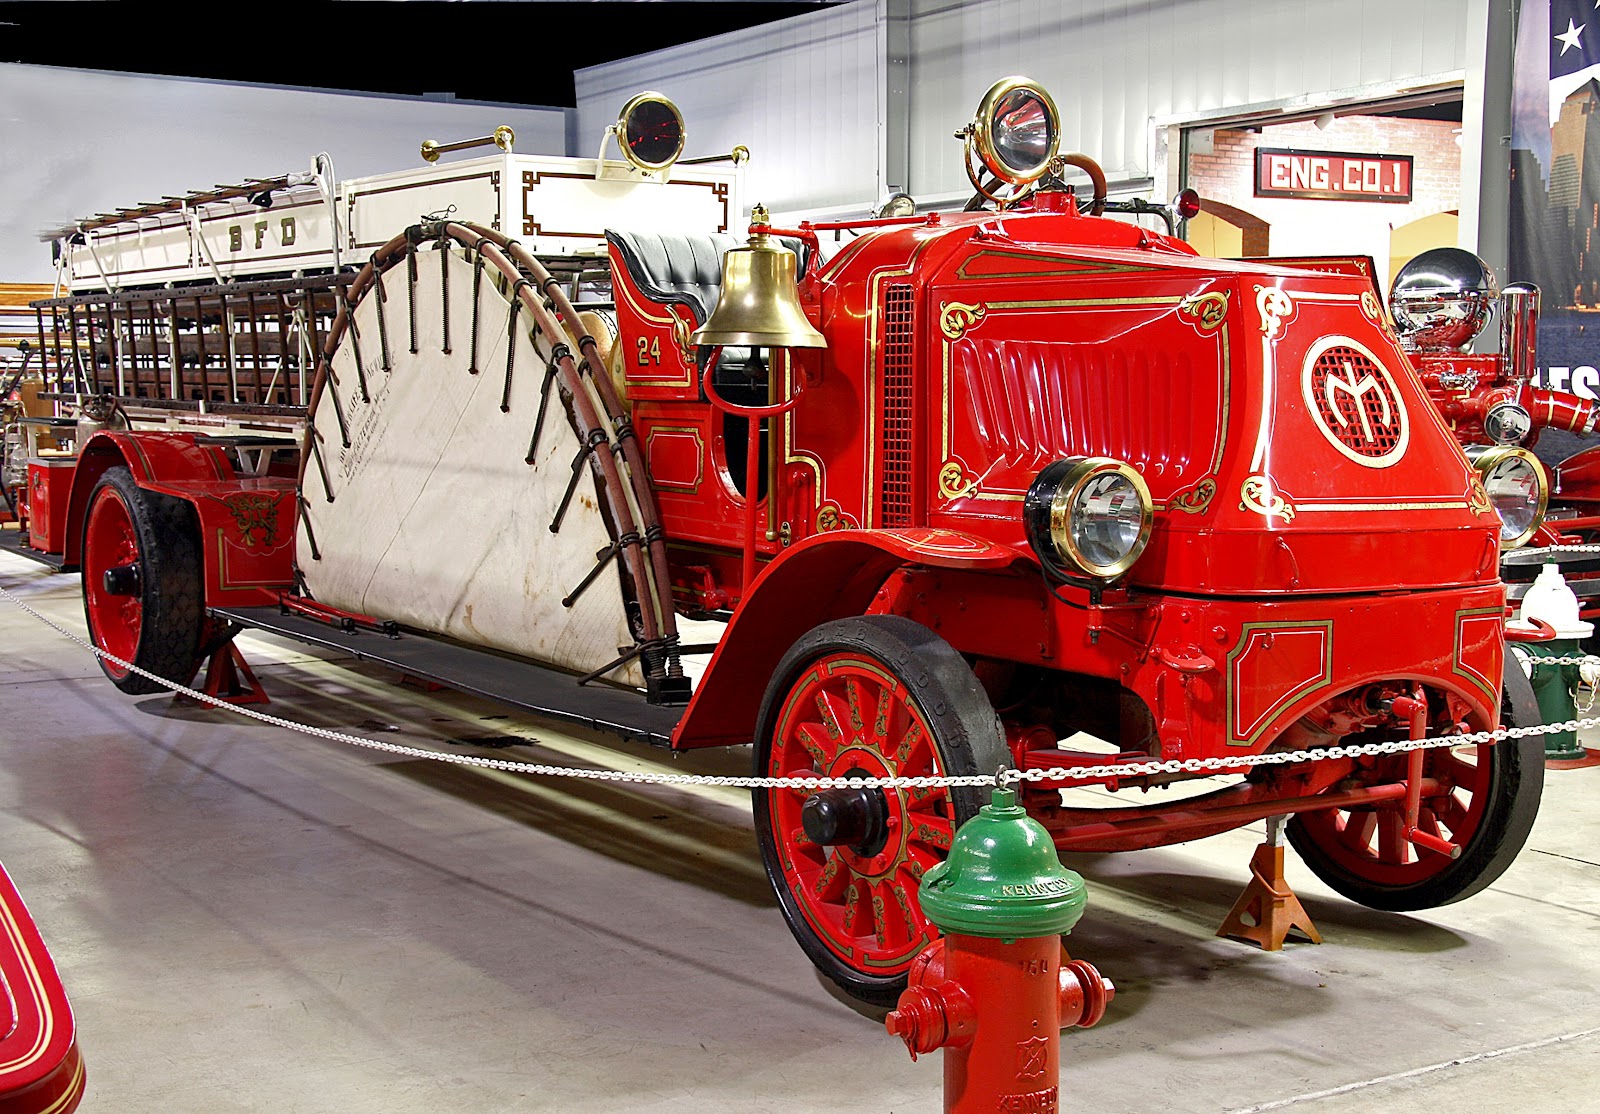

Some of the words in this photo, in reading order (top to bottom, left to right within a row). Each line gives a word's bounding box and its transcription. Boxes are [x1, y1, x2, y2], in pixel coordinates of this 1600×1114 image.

[1271, 156, 1400, 193] ENG.CO.1
[637, 336, 661, 367] 24
[1002, 878, 1073, 897] KENNEDY
